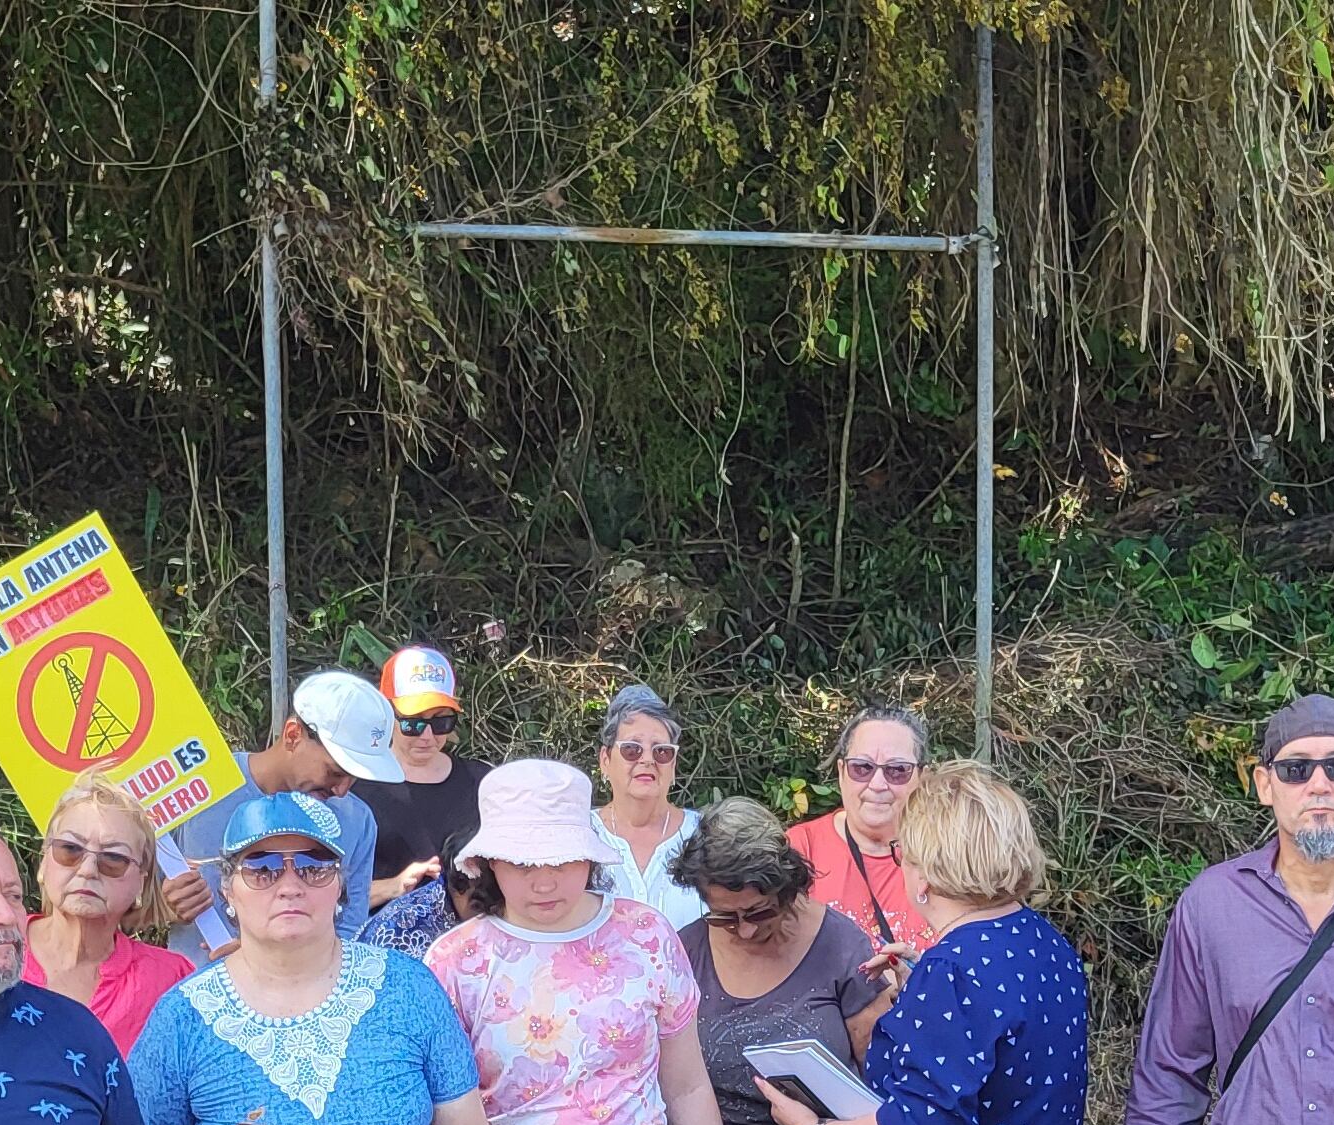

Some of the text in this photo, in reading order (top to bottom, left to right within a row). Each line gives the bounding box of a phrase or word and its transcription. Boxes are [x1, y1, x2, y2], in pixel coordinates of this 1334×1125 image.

[24, 529, 109, 593] ANTENA
[126, 740, 206, 800] LUD ES
[147, 778, 209, 828] MERO
